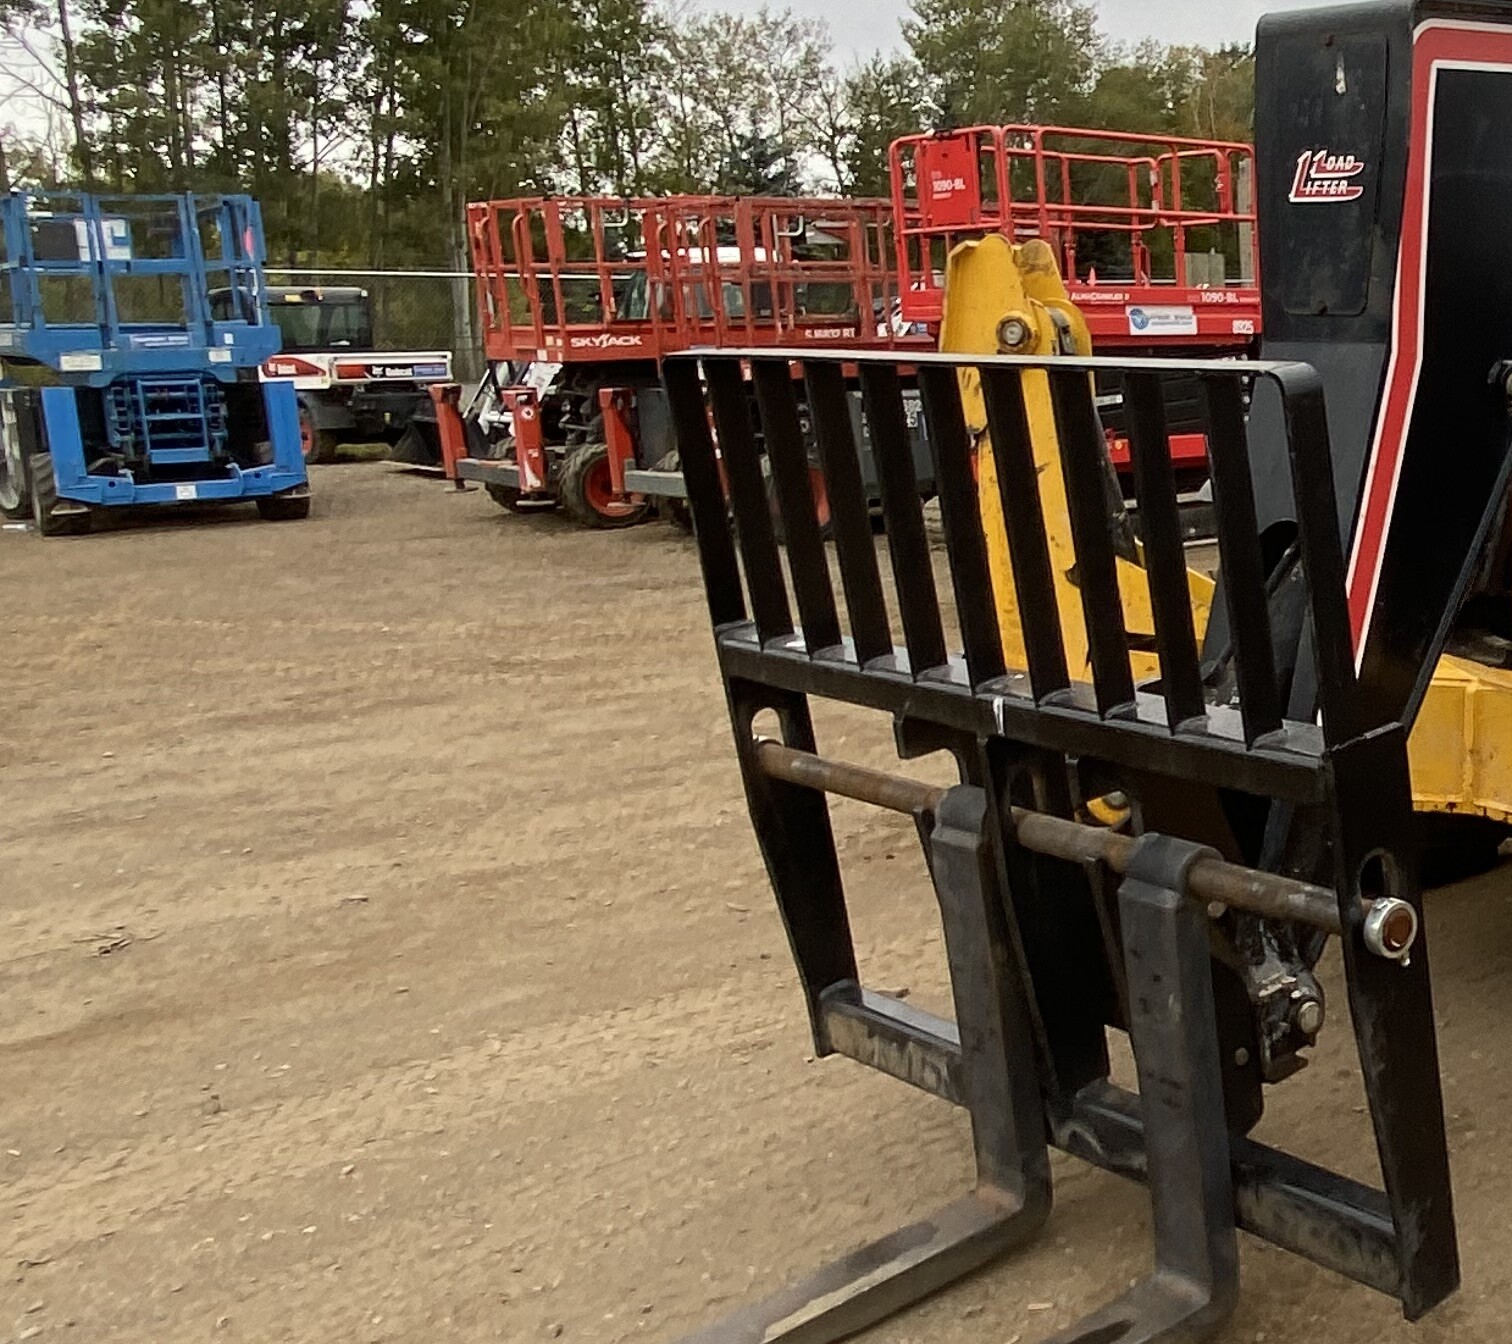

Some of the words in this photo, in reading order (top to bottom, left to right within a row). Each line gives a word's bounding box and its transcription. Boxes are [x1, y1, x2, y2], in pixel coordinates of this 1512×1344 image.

[1288, 150, 1364, 203] LIFTER
[1309, 149, 1365, 179] LOAD
[570, 333, 643, 349] SKYJACK
